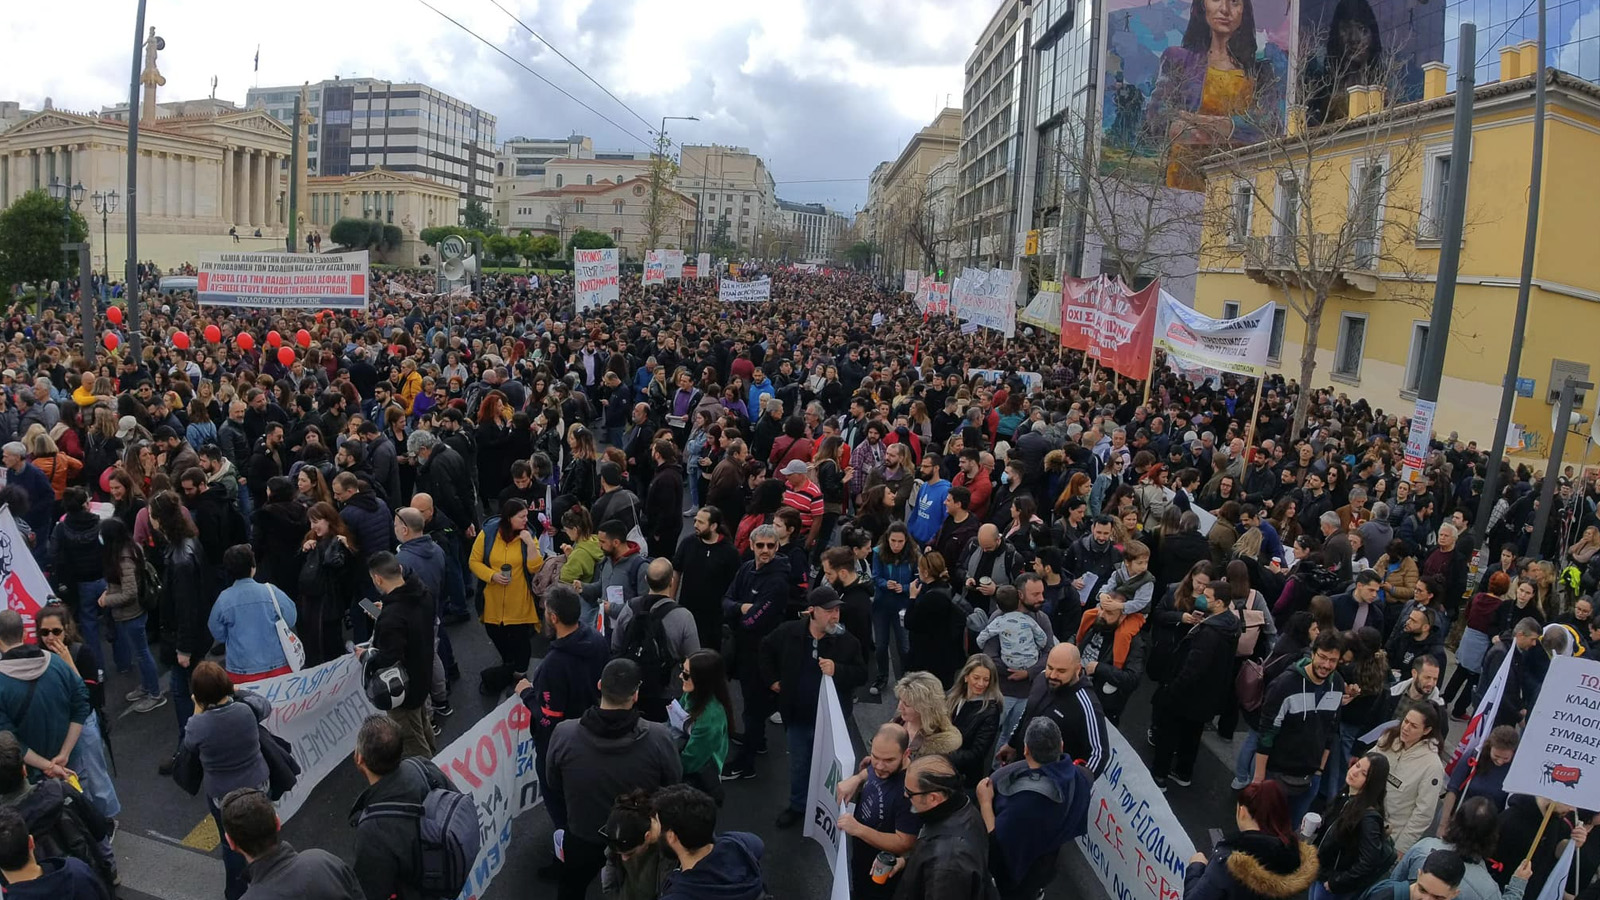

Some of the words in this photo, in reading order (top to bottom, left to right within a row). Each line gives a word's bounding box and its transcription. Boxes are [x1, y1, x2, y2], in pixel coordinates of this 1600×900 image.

[220, 254, 240, 262] ΚΑΜΙΑ
[241, 255, 262, 263] ΑΝΟΧΗ
[262, 255, 280, 264] ΣΤΗΝ
[201, 262, 213, 270] ΤΗΝ
[213, 263, 253, 271] ΥΠΟΒΑΘΜΙΣΗ
[254, 264, 267, 272] ΤΩΝ
[211, 274, 235, 283] ΛΕΦΤΑ
[236, 274, 247, 283] ΓΙΑ
[250, 275, 264, 284] ΤΗΝ
[294, 275, 317, 284] ΣΧΟΛΕΙΑ
[318, 275, 348, 285] ΑΣΦΑΛΗ,
[210, 284, 239, 293] ΑΥΞΗΣΕΙΣ
[240, 284, 260, 293] ΣΤΟΥΣ
[261, 285, 288, 294] ΜΙΣΘΟΥΣ
[299, 286, 348, 295] ΕΚΠΑΙΔΕΥΤΙΚΩΝ!
[236, 296, 269, 304] ΣΥΛΛΟΓΟΙ
[1067, 309, 1083, 321] ΟΧΙ
[1545, 743, 1598, 765] ΕΡΓΑΣΙΑΣ
[1118, 784, 1137, 814] ΤΟΥ
[1130, 799, 1187, 880] ΕΙΣΟΔΗΜ
